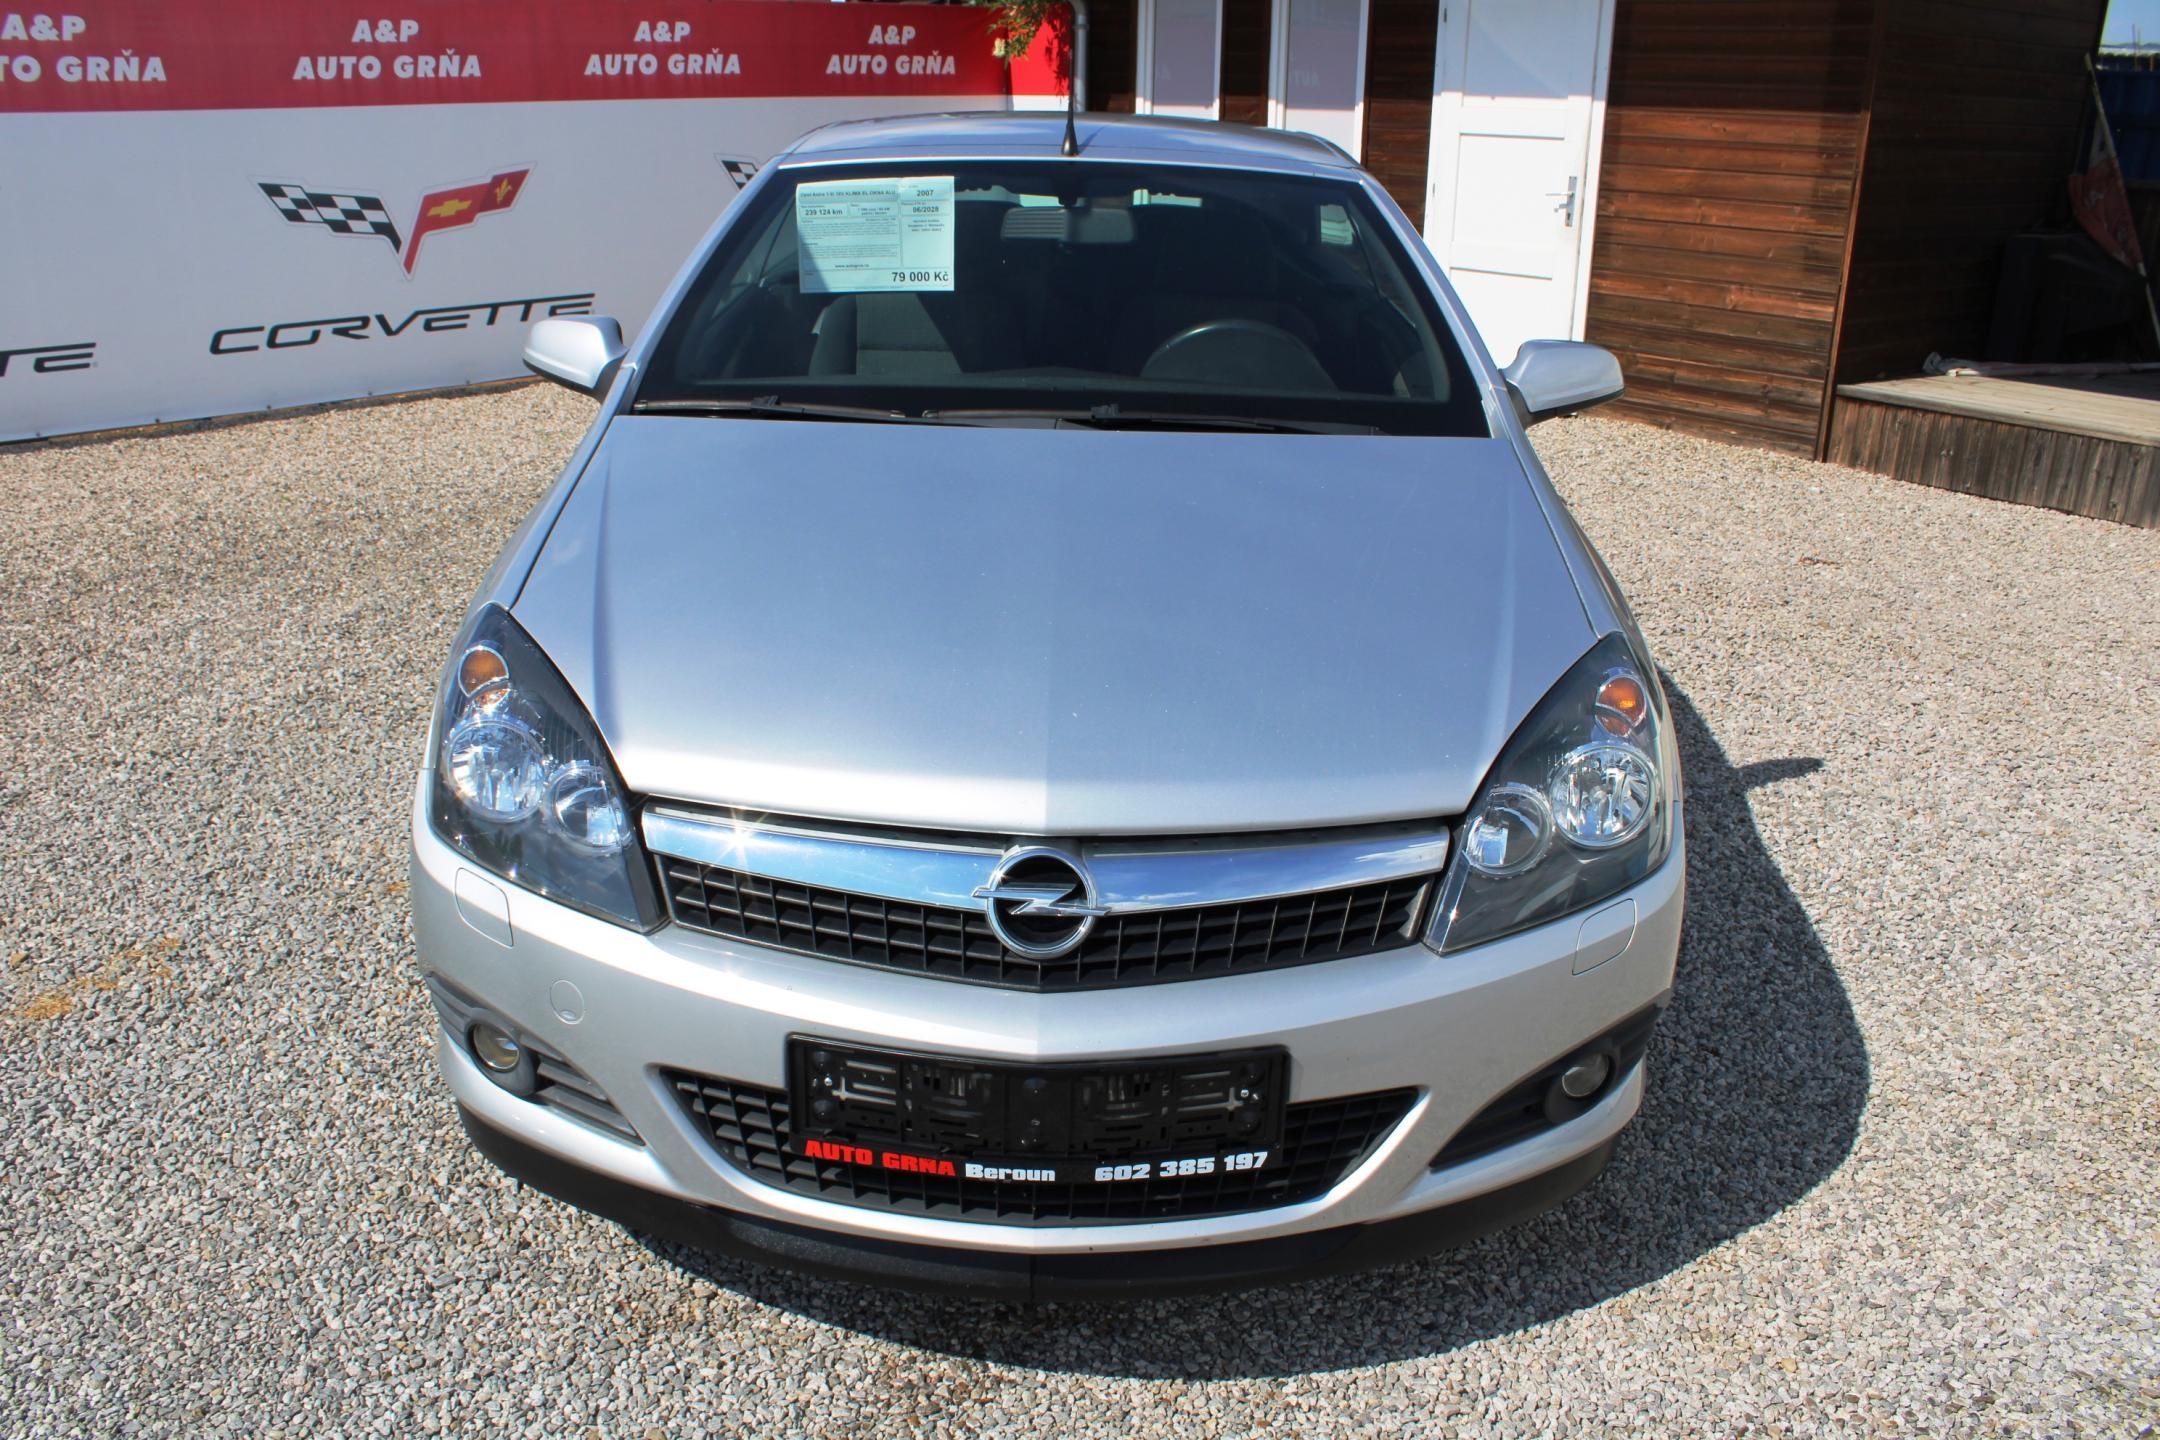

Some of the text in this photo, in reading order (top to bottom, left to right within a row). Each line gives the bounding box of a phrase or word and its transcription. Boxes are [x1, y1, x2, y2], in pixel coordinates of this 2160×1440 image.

[1, 13, 86, 41] A&P
[351, 19, 419, 43] A&P
[634, 20, 690, 42] A&P
[868, 25, 916, 45] A&P
[56, 49, 167, 82] GRŇA
[292, 48, 481, 80] AUTO GRŇA
[584, 47, 741, 76] AUTO GRŇA
[825, 50, 956, 75] AUTO GRŇA
[917, 189, 934, 197] 2007
[891, 270, 949, 282] 79 000 Kč
[209, 293, 595, 355] CORVETTE
[804, 1139, 1268, 1182] AUTO GRNA Beroun 602 385 197
